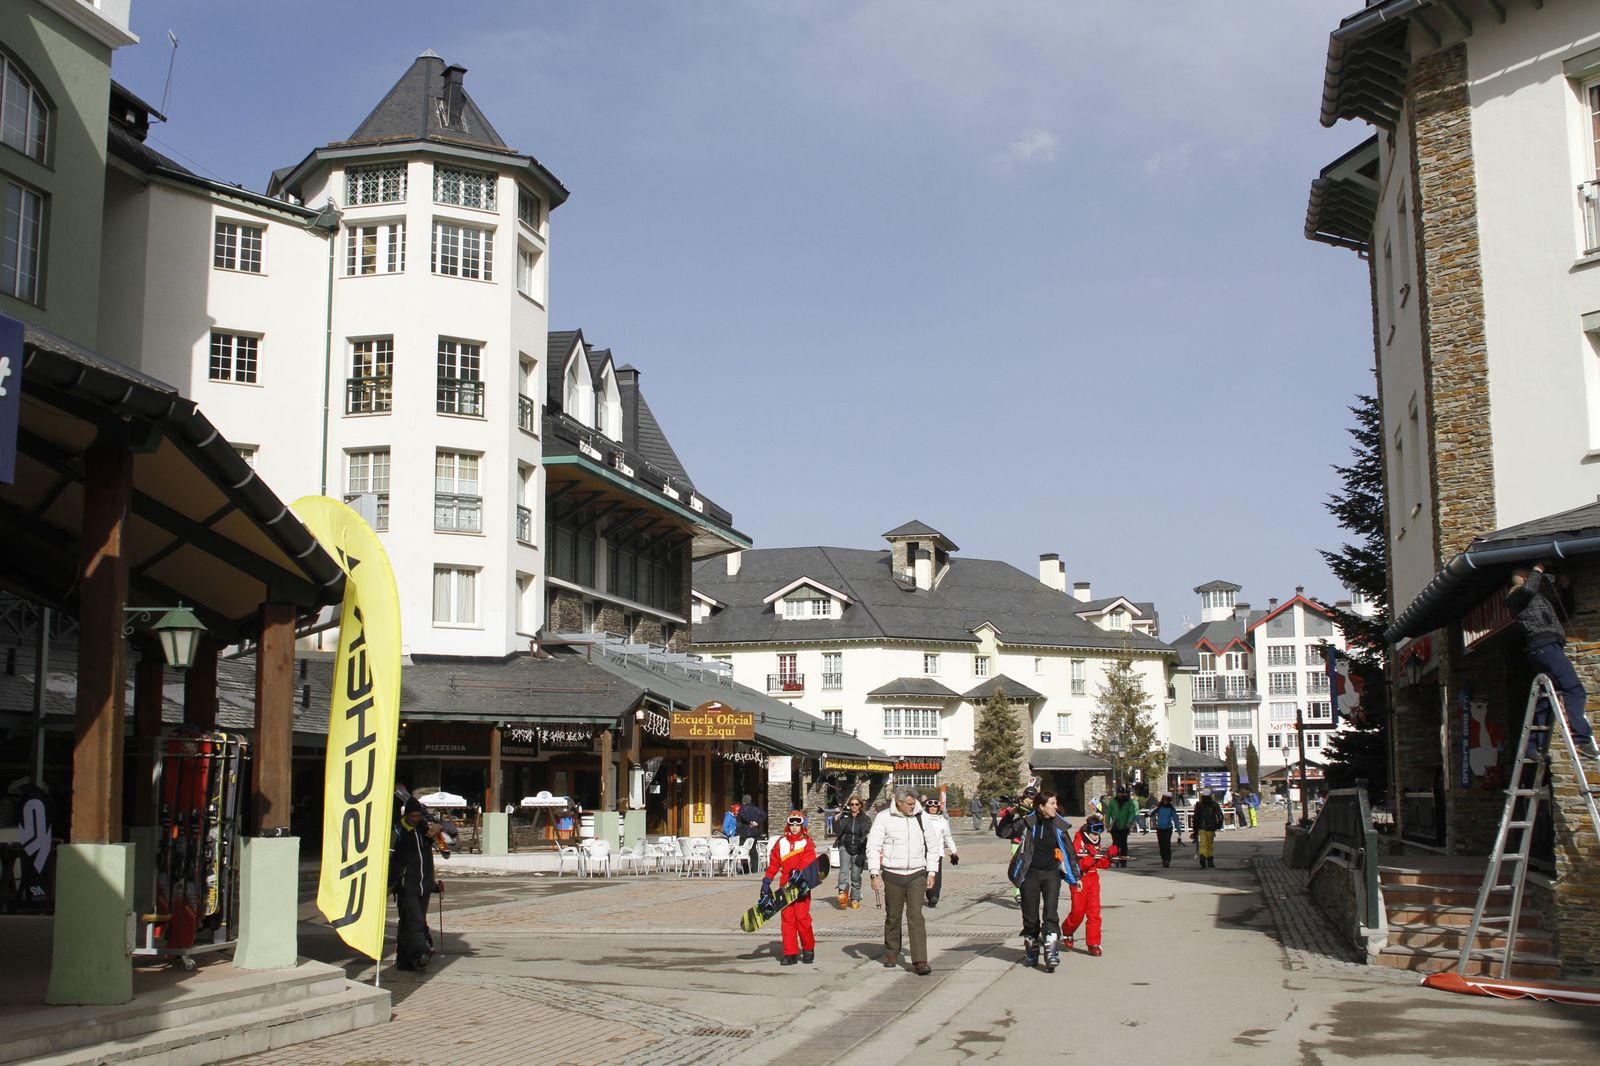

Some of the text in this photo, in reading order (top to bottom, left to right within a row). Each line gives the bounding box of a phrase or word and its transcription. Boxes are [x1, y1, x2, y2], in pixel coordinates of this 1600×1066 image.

[673, 713, 753, 725] Escuela Oficial
[689, 725, 737, 739] de Esquí
[425, 744, 466, 752] PIZZERIA
[895, 762, 941, 770] SUPERMERCADO
